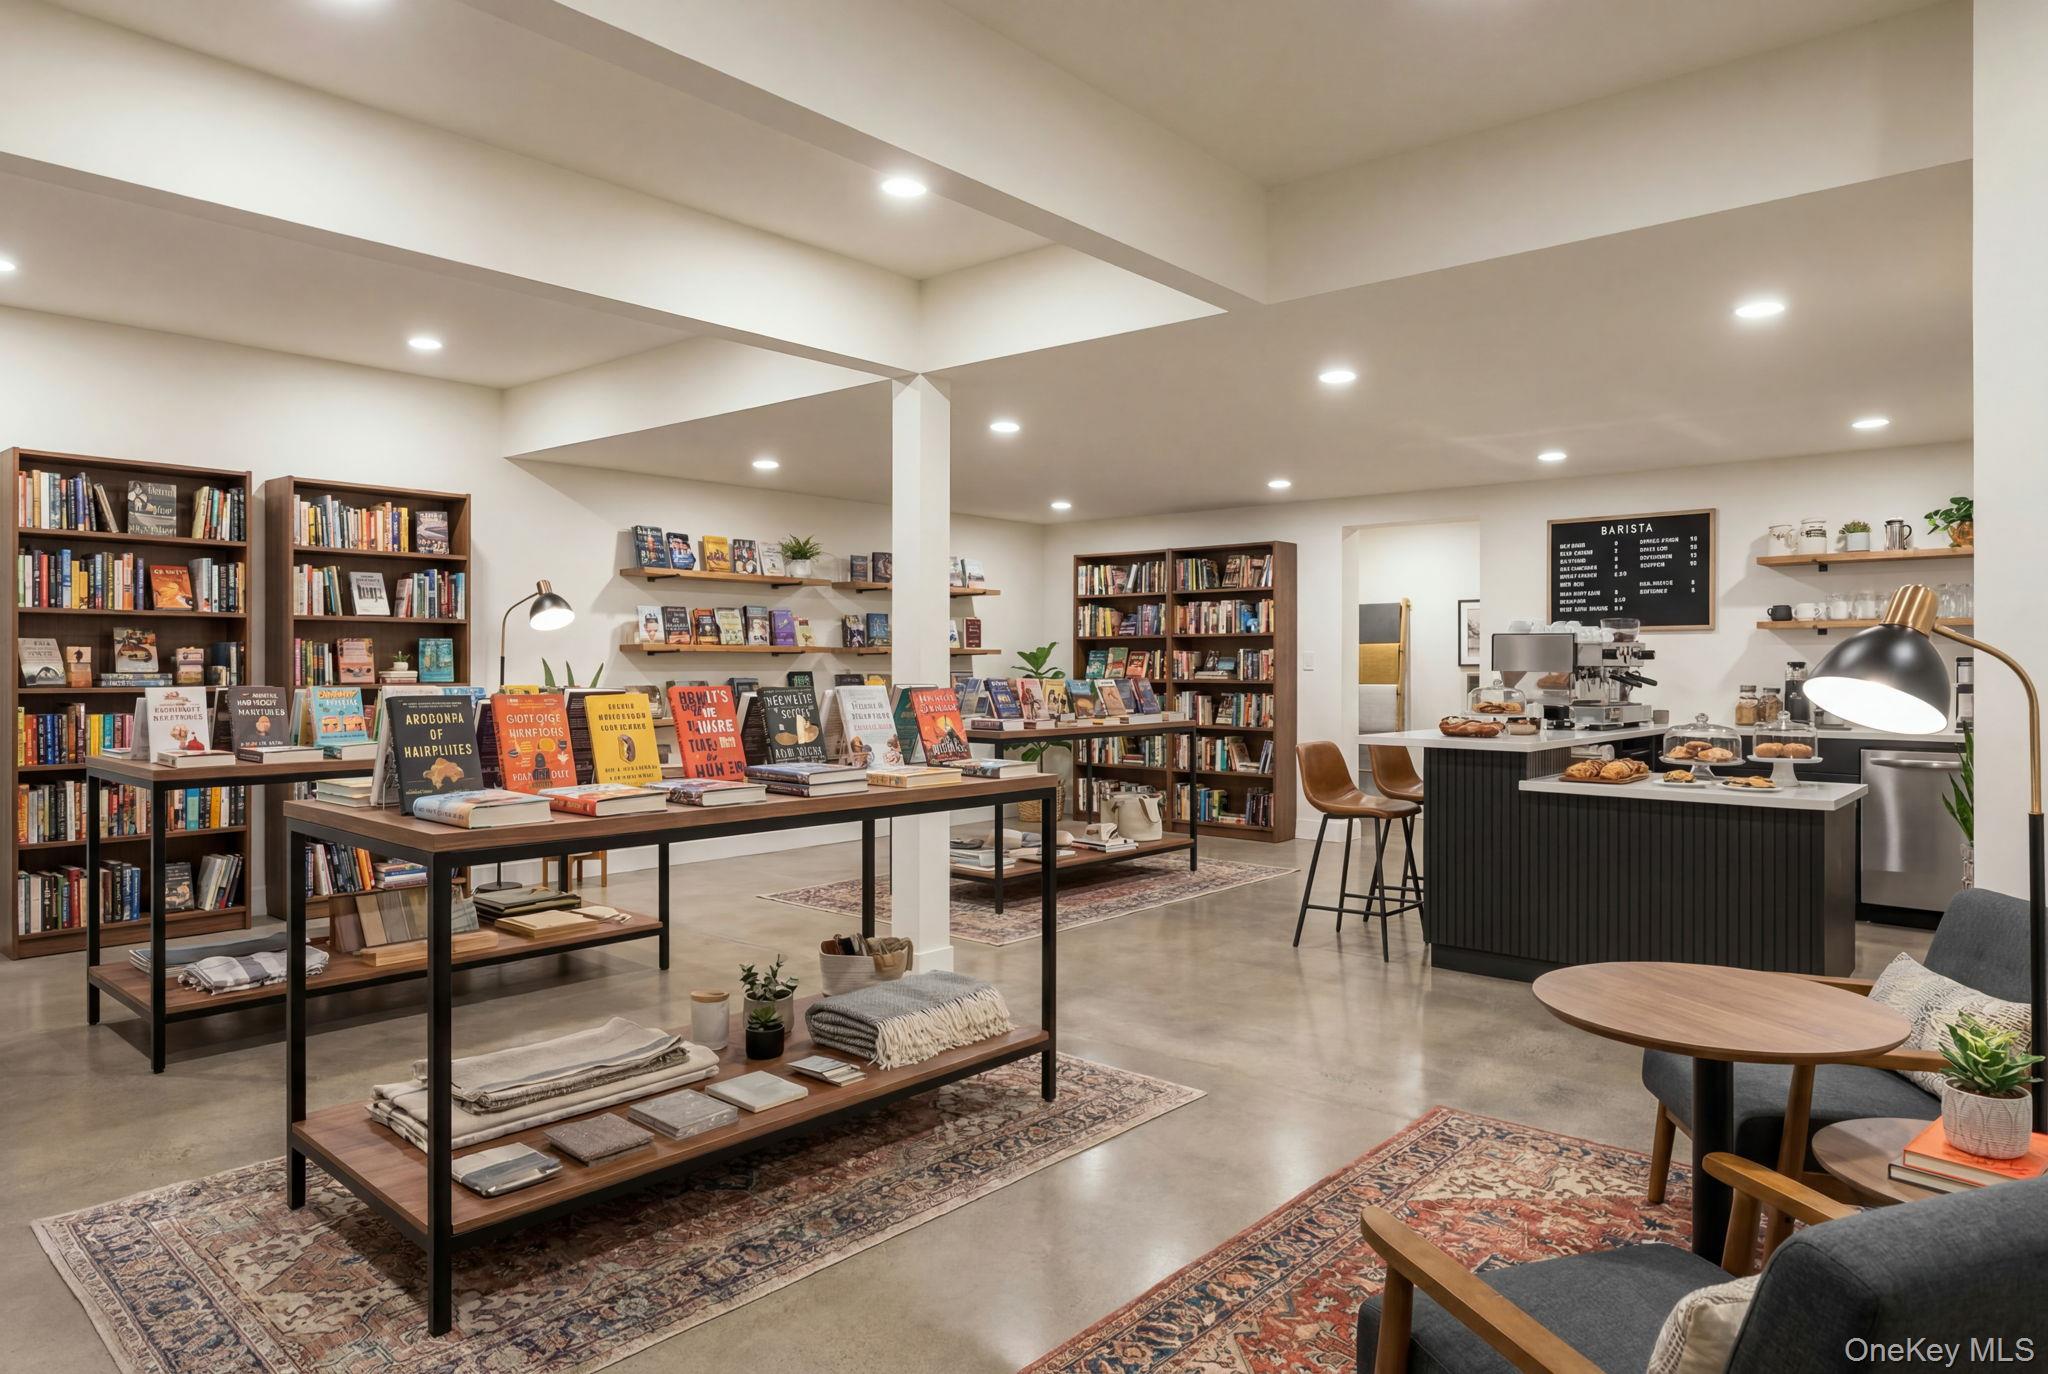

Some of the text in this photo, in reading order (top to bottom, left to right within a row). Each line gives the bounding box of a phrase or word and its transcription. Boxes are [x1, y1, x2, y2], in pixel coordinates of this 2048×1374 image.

[1601, 523, 1653, 535] BARISTA
[706, 690, 729, 704] IT'S
[430, 728, 443, 740] OF
